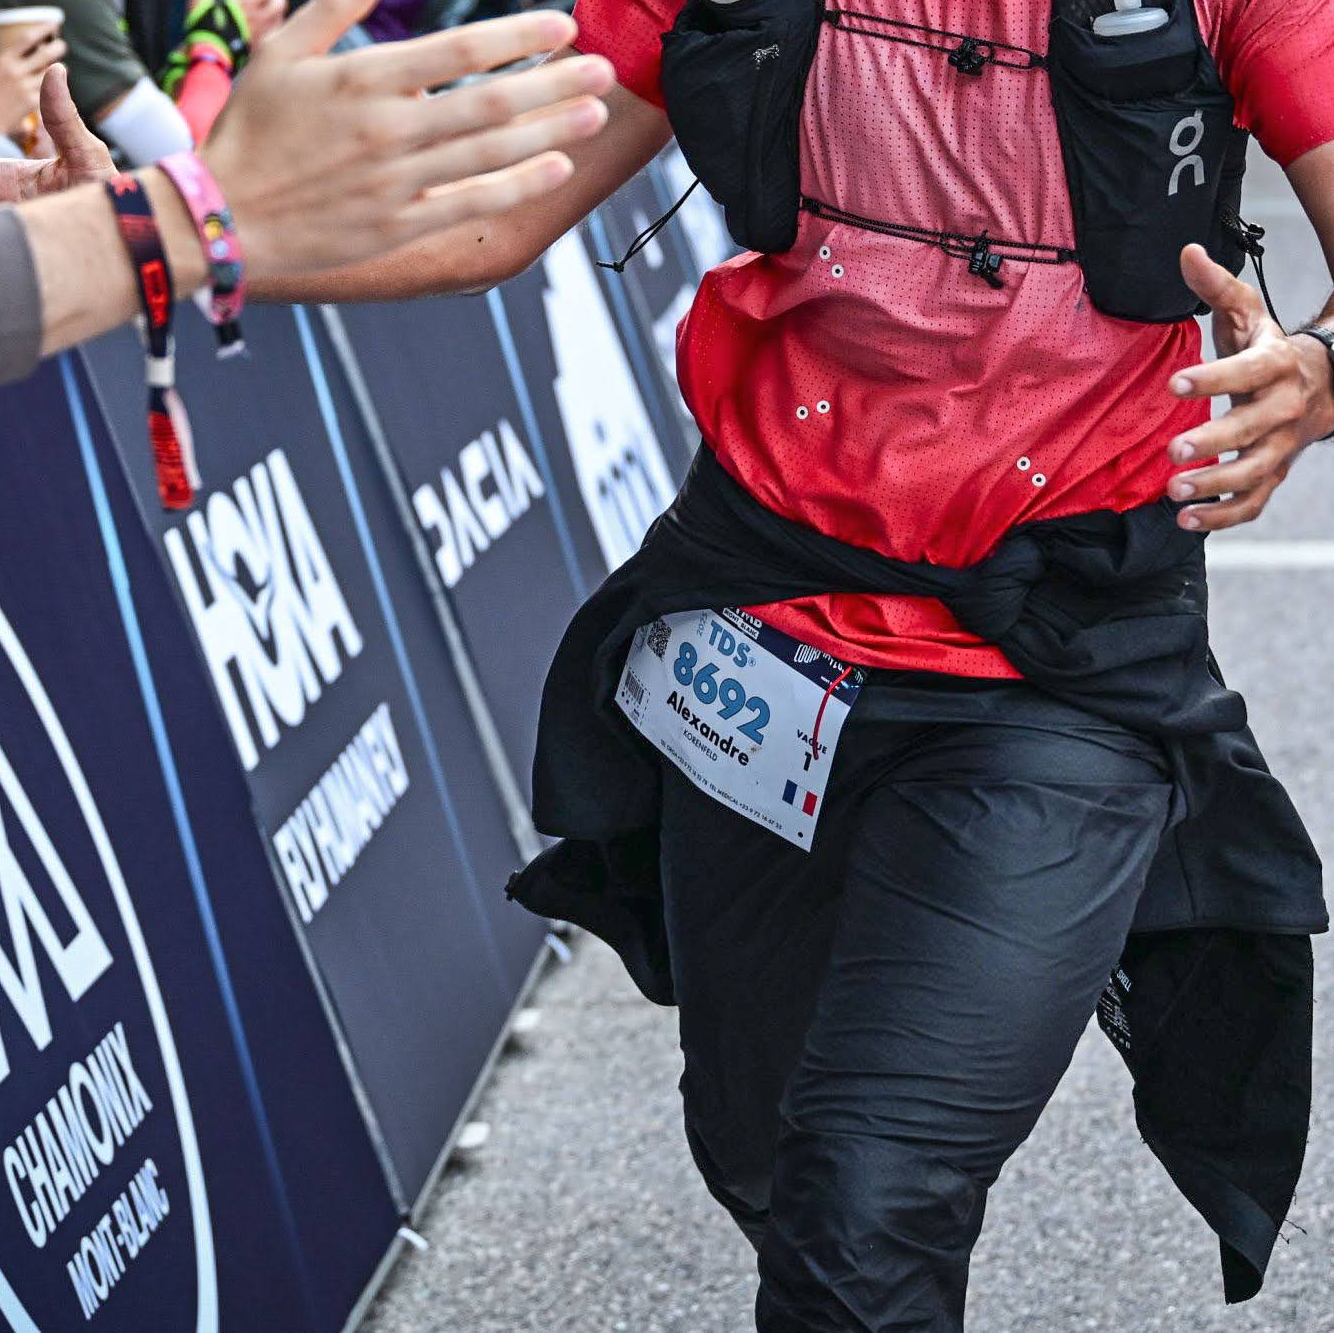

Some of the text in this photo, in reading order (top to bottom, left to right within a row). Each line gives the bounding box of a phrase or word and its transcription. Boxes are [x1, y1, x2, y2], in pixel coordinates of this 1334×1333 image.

[412, 417, 545, 588] DACIA
[165, 448, 363, 771] HOKA
[666, 690, 750, 767] Alexandre
[673, 641, 771, 746] 8692
[683, 728, 718, 763] KORENFELD
[803, 751, 812, 772] 1
[272, 701, 410, 924] FLY HUMAN FLY
[3, 1021, 154, 1249] CHAMONIX
[66, 1158, 170, 1321] MONT-BLANC
